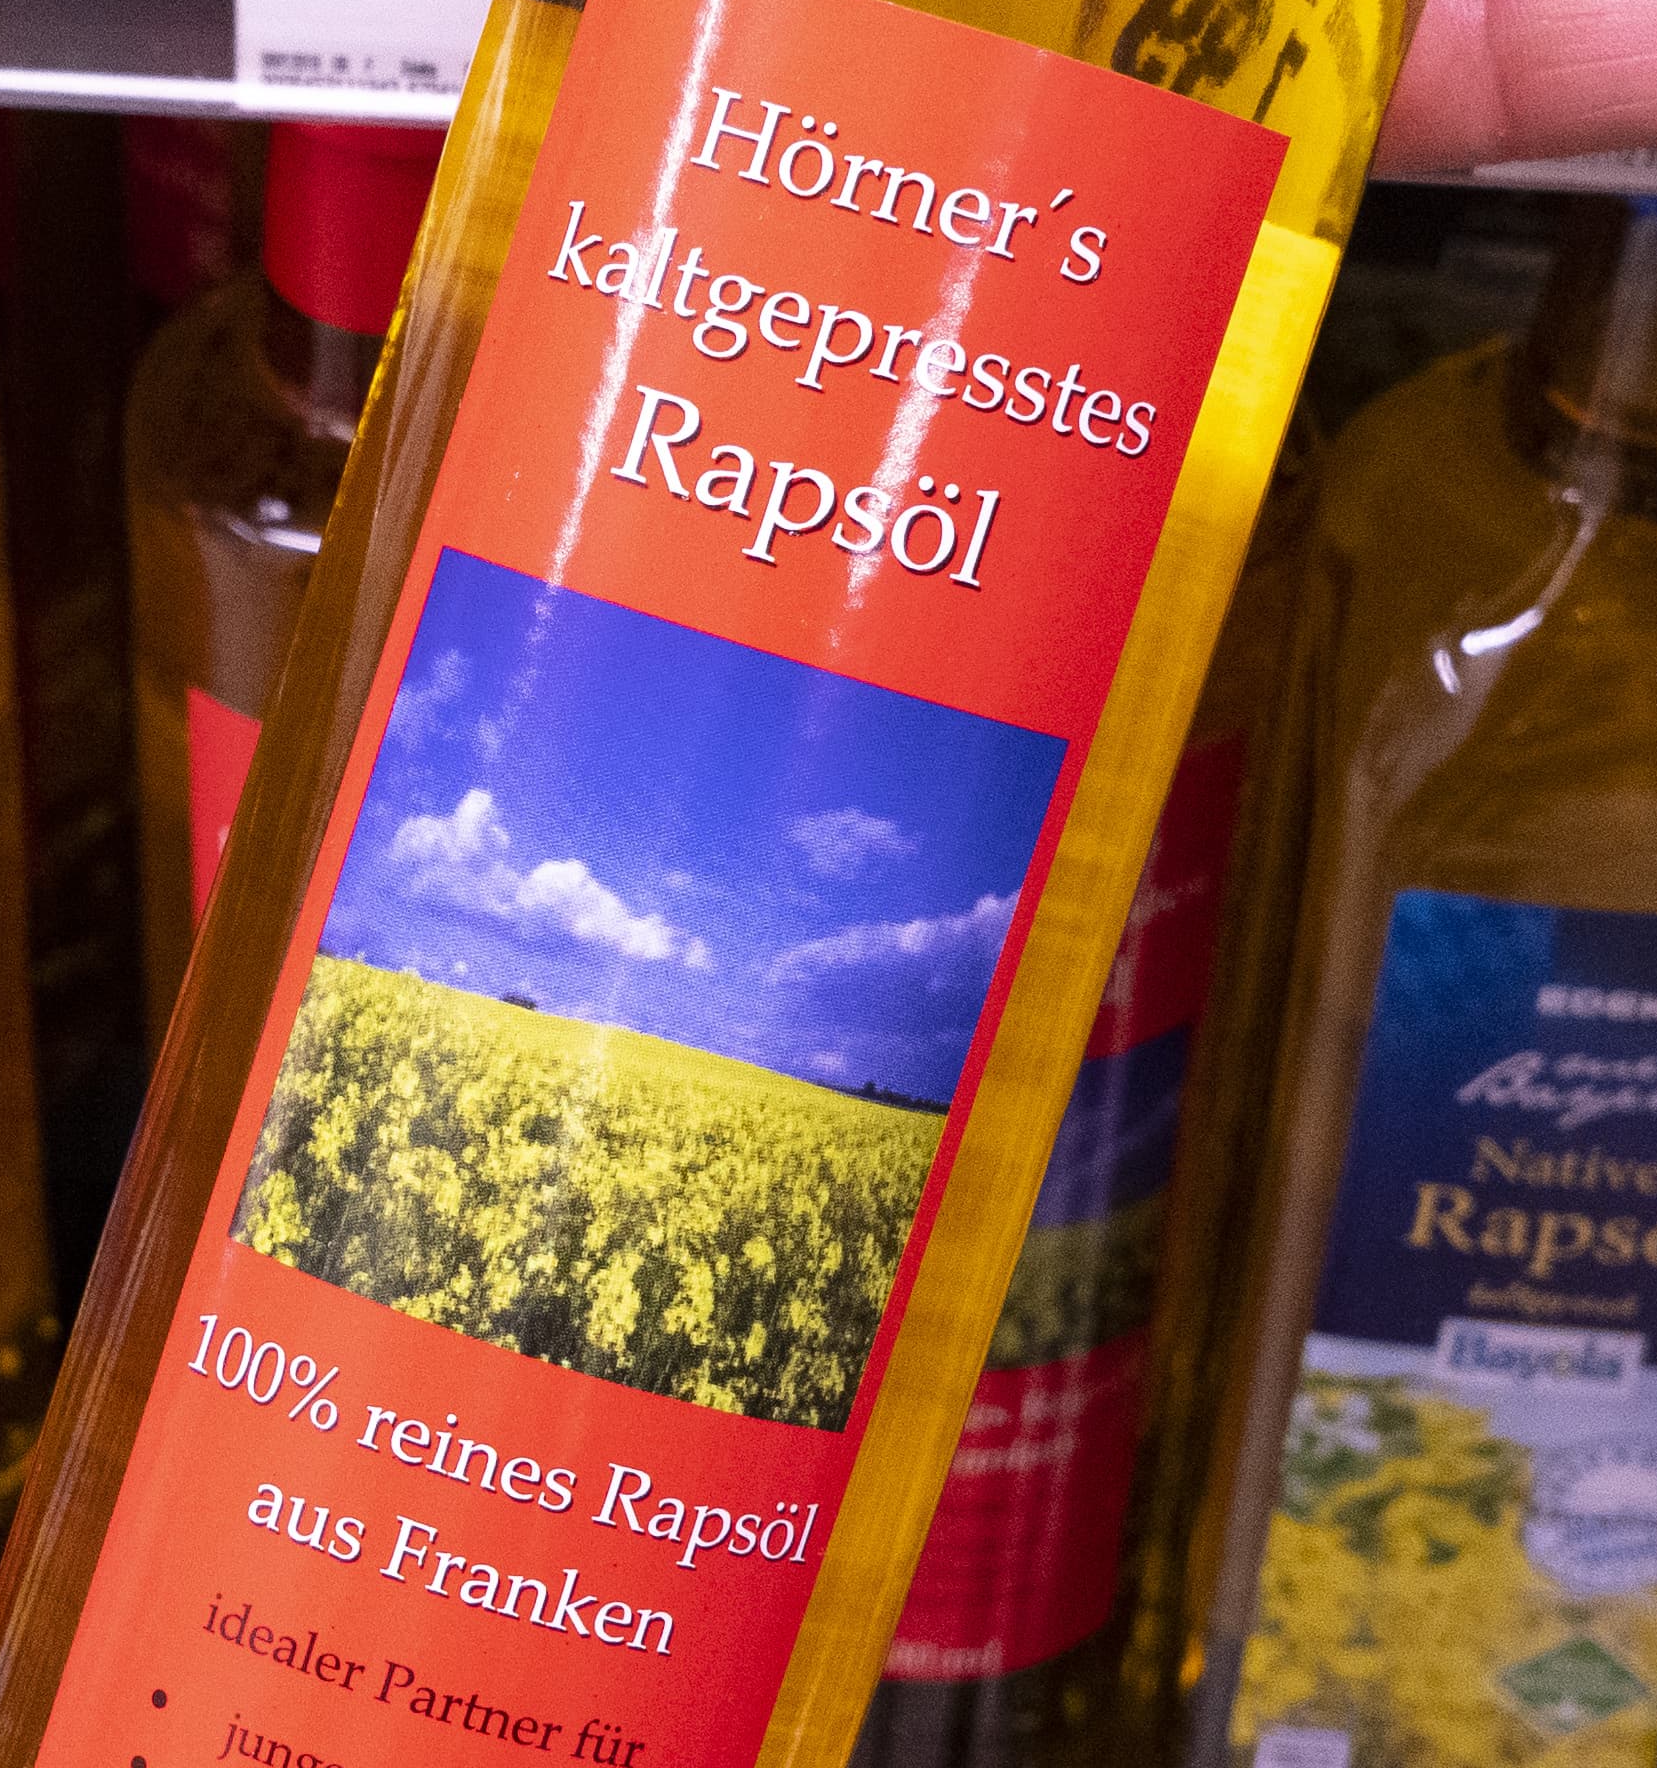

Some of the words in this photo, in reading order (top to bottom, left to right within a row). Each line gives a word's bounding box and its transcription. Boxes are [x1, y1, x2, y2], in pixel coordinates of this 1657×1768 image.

[547, 200, 1158, 459] kaltgepresstes
[610, 384, 1004, 591] Rapsöl
[187, 1313, 341, 1433] 100%
[356, 1404, 578, 1516] reines
[591, 1461, 821, 1571] Rapsöl
[247, 1481, 368, 1565] aus
[379, 1513, 678, 1658] Franken
[202, 1592, 366, 1695] idealer
[373, 1657, 563, 1757] Partner
